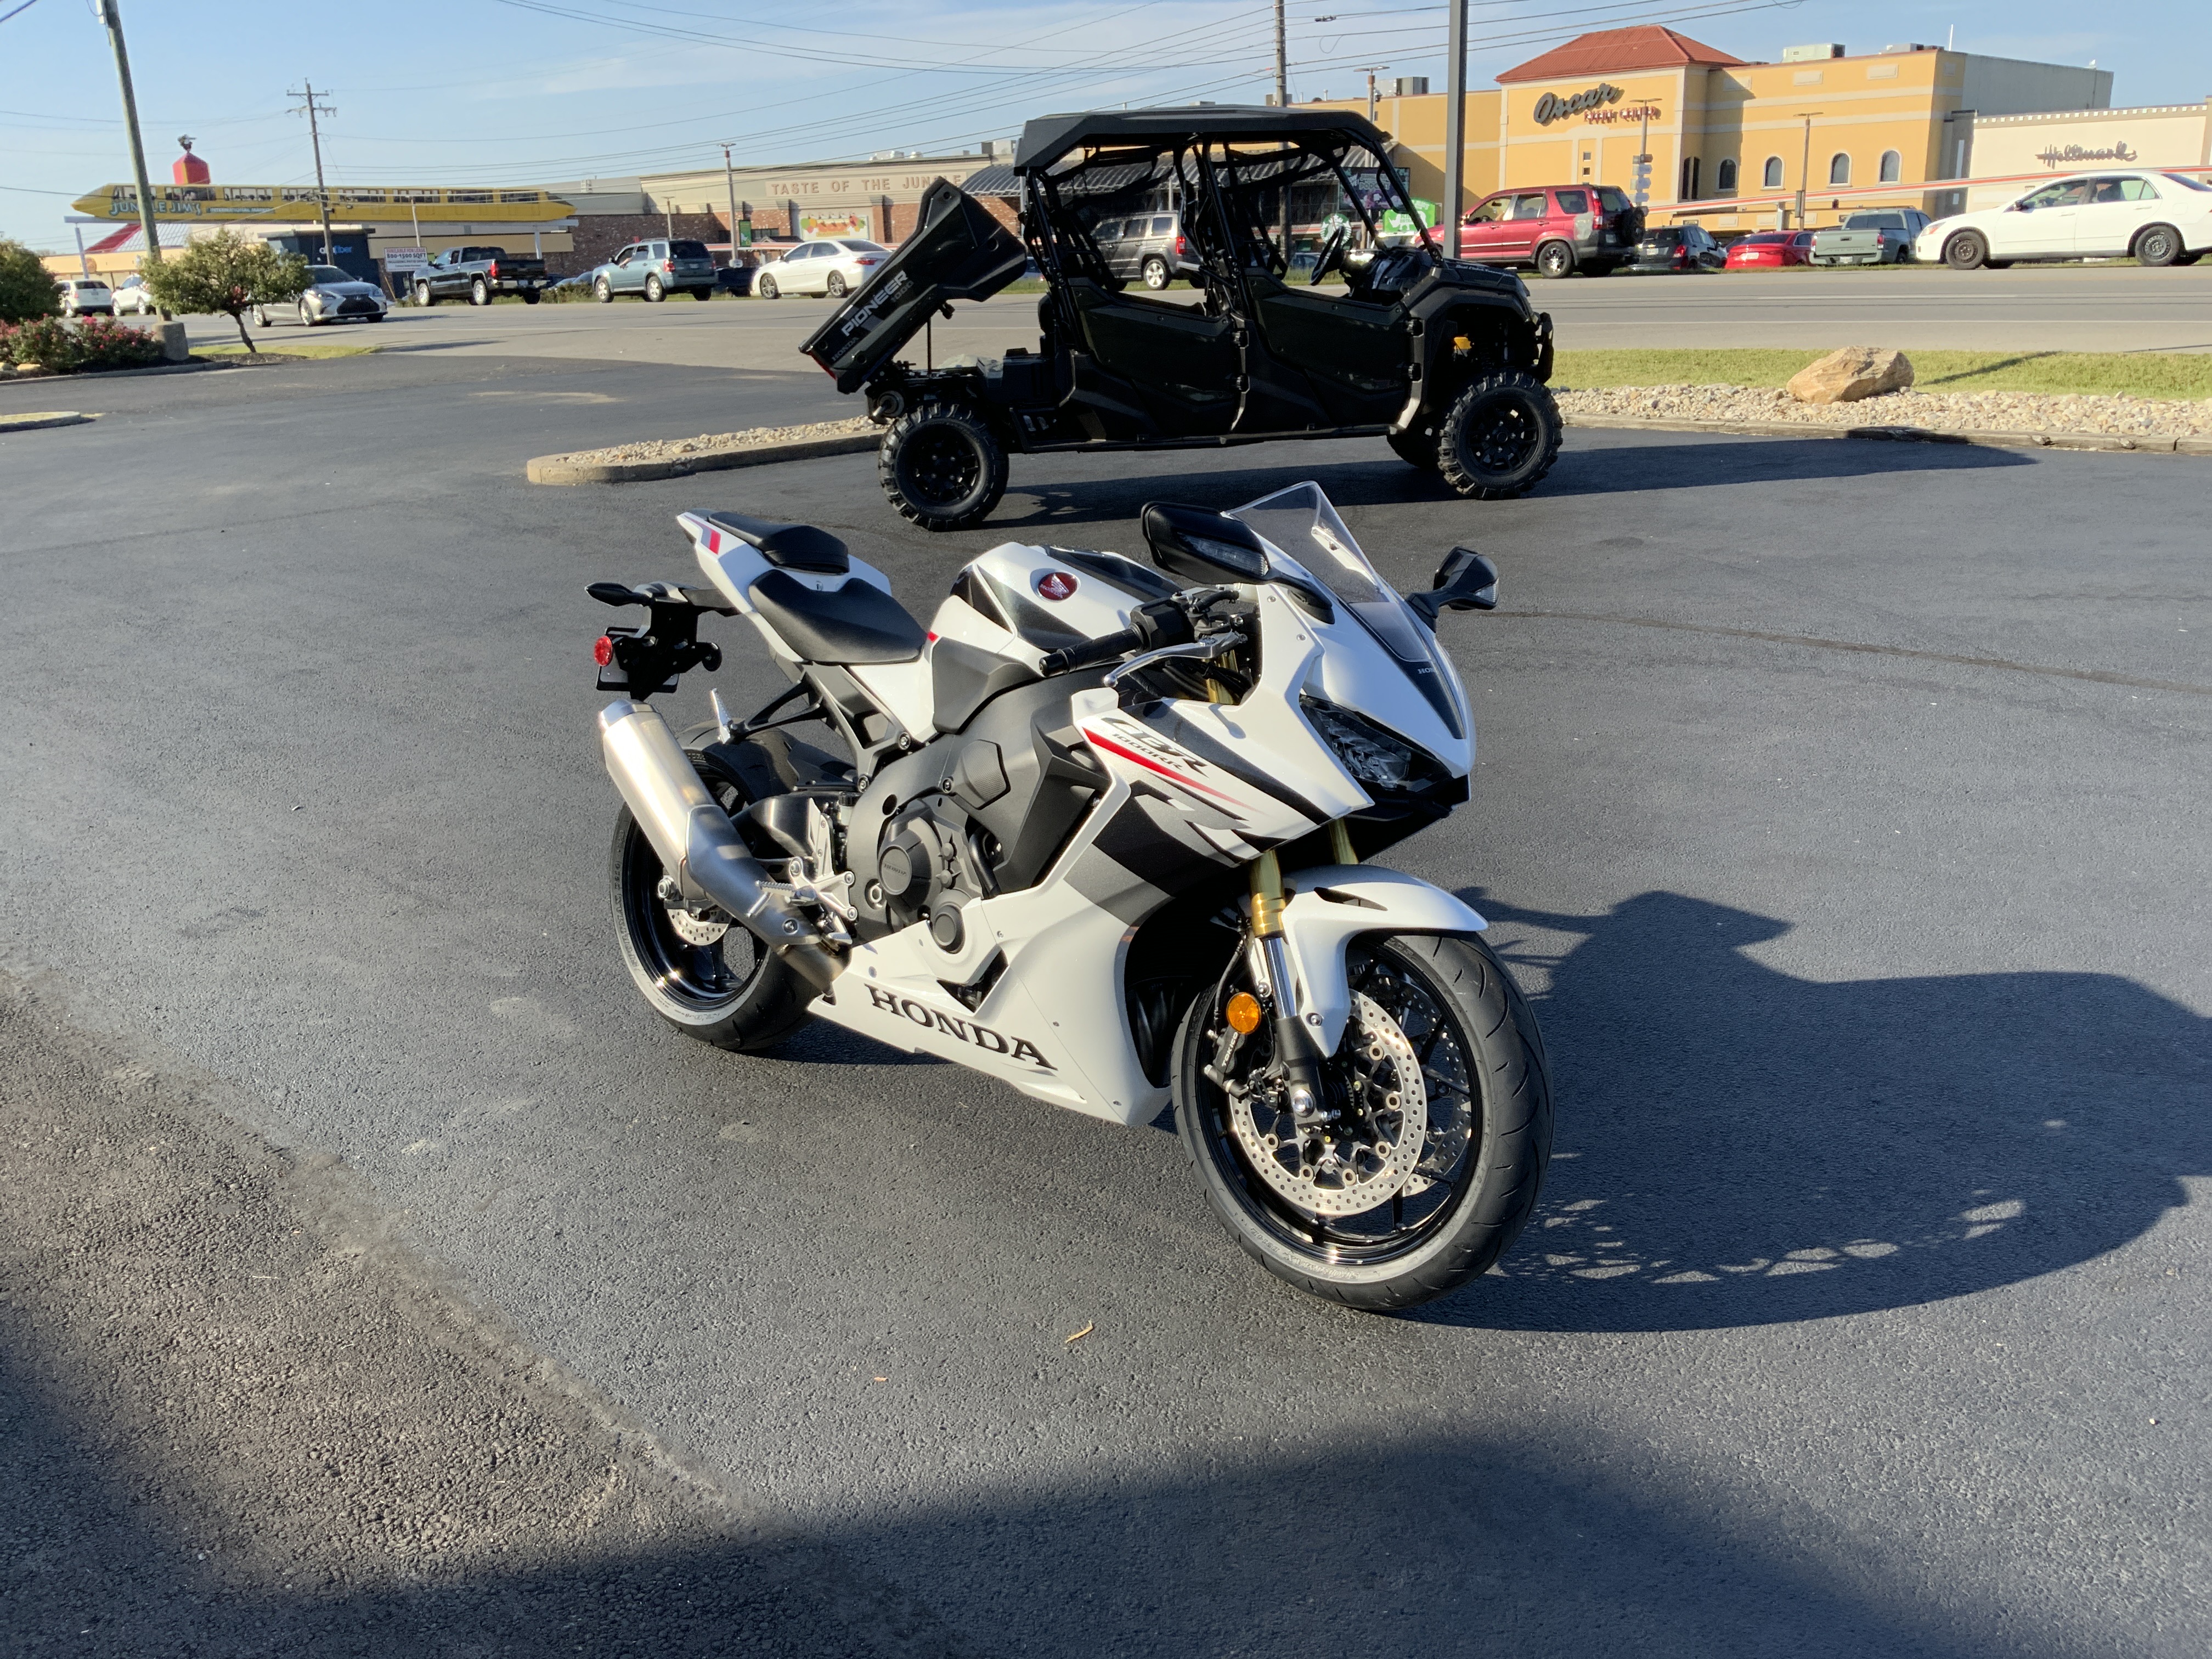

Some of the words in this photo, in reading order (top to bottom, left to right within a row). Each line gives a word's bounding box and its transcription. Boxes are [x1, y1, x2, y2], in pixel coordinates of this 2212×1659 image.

[1533, 83, 1618, 123] Oscar
[1584, 109, 1614, 122] EVENT
[1619, 106, 1657, 119] CENTR
[2035, 140, 2138, 170] Hallmark
[771, 182, 820, 195] TASTE
[831, 180, 849, 193] OF
[861, 178, 890, 191] THE
[902, 174, 962, 189] JUNE
[1359, 182, 1391, 190] PODCT
[109, 201, 166, 216] JUNLE
[170, 201, 202, 216] JIM'S
[841, 270, 909, 337] PIONEER
[890, 280, 915, 302] 1000
[831, 337, 859, 362] HONDA
[1040, 583, 1063, 599] HONDA
[1101, 717, 1210, 779] CBR
[1112, 732, 1184, 771] 1000RR
[884, 863, 907, 875] HONDA
[863, 983, 1059, 1071] HONDA
[1221, 1031, 1238, 1066] TOKICO
